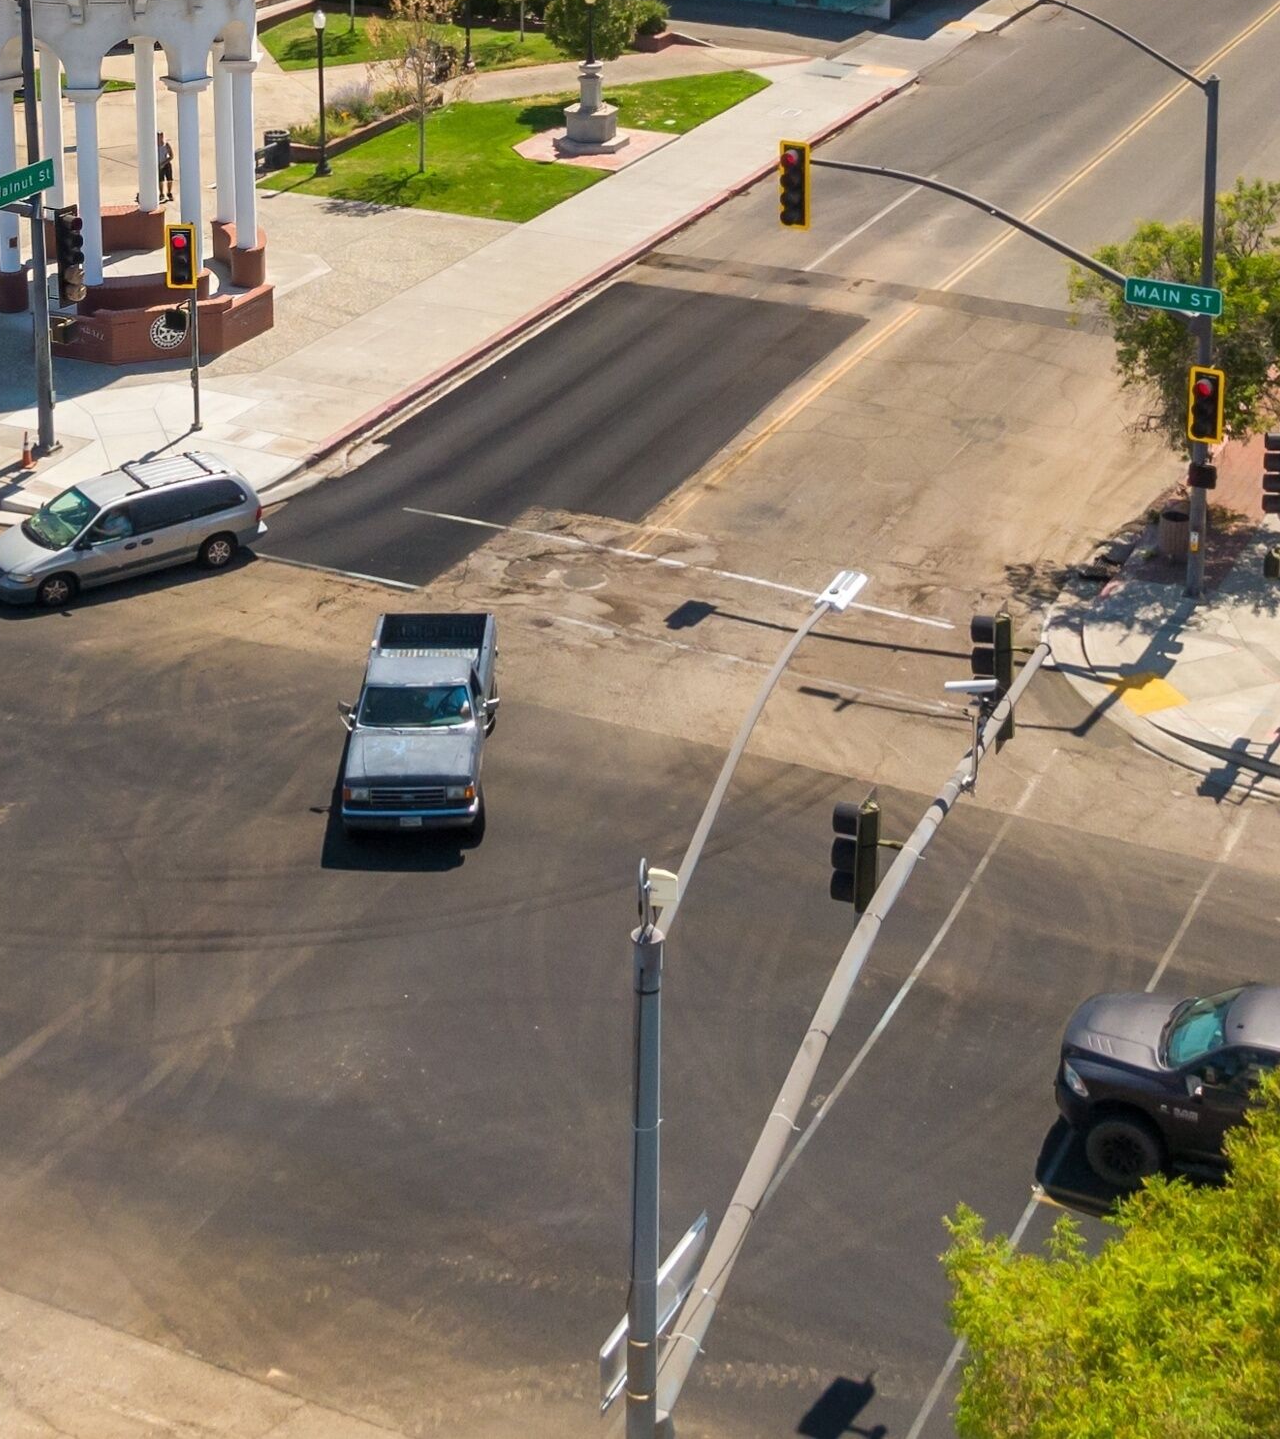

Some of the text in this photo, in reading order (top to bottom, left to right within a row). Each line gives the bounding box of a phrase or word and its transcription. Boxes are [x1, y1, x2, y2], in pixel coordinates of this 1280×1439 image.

[39, 168, 51, 182] St
[1133, 284, 1213, 308] MAIN ST
